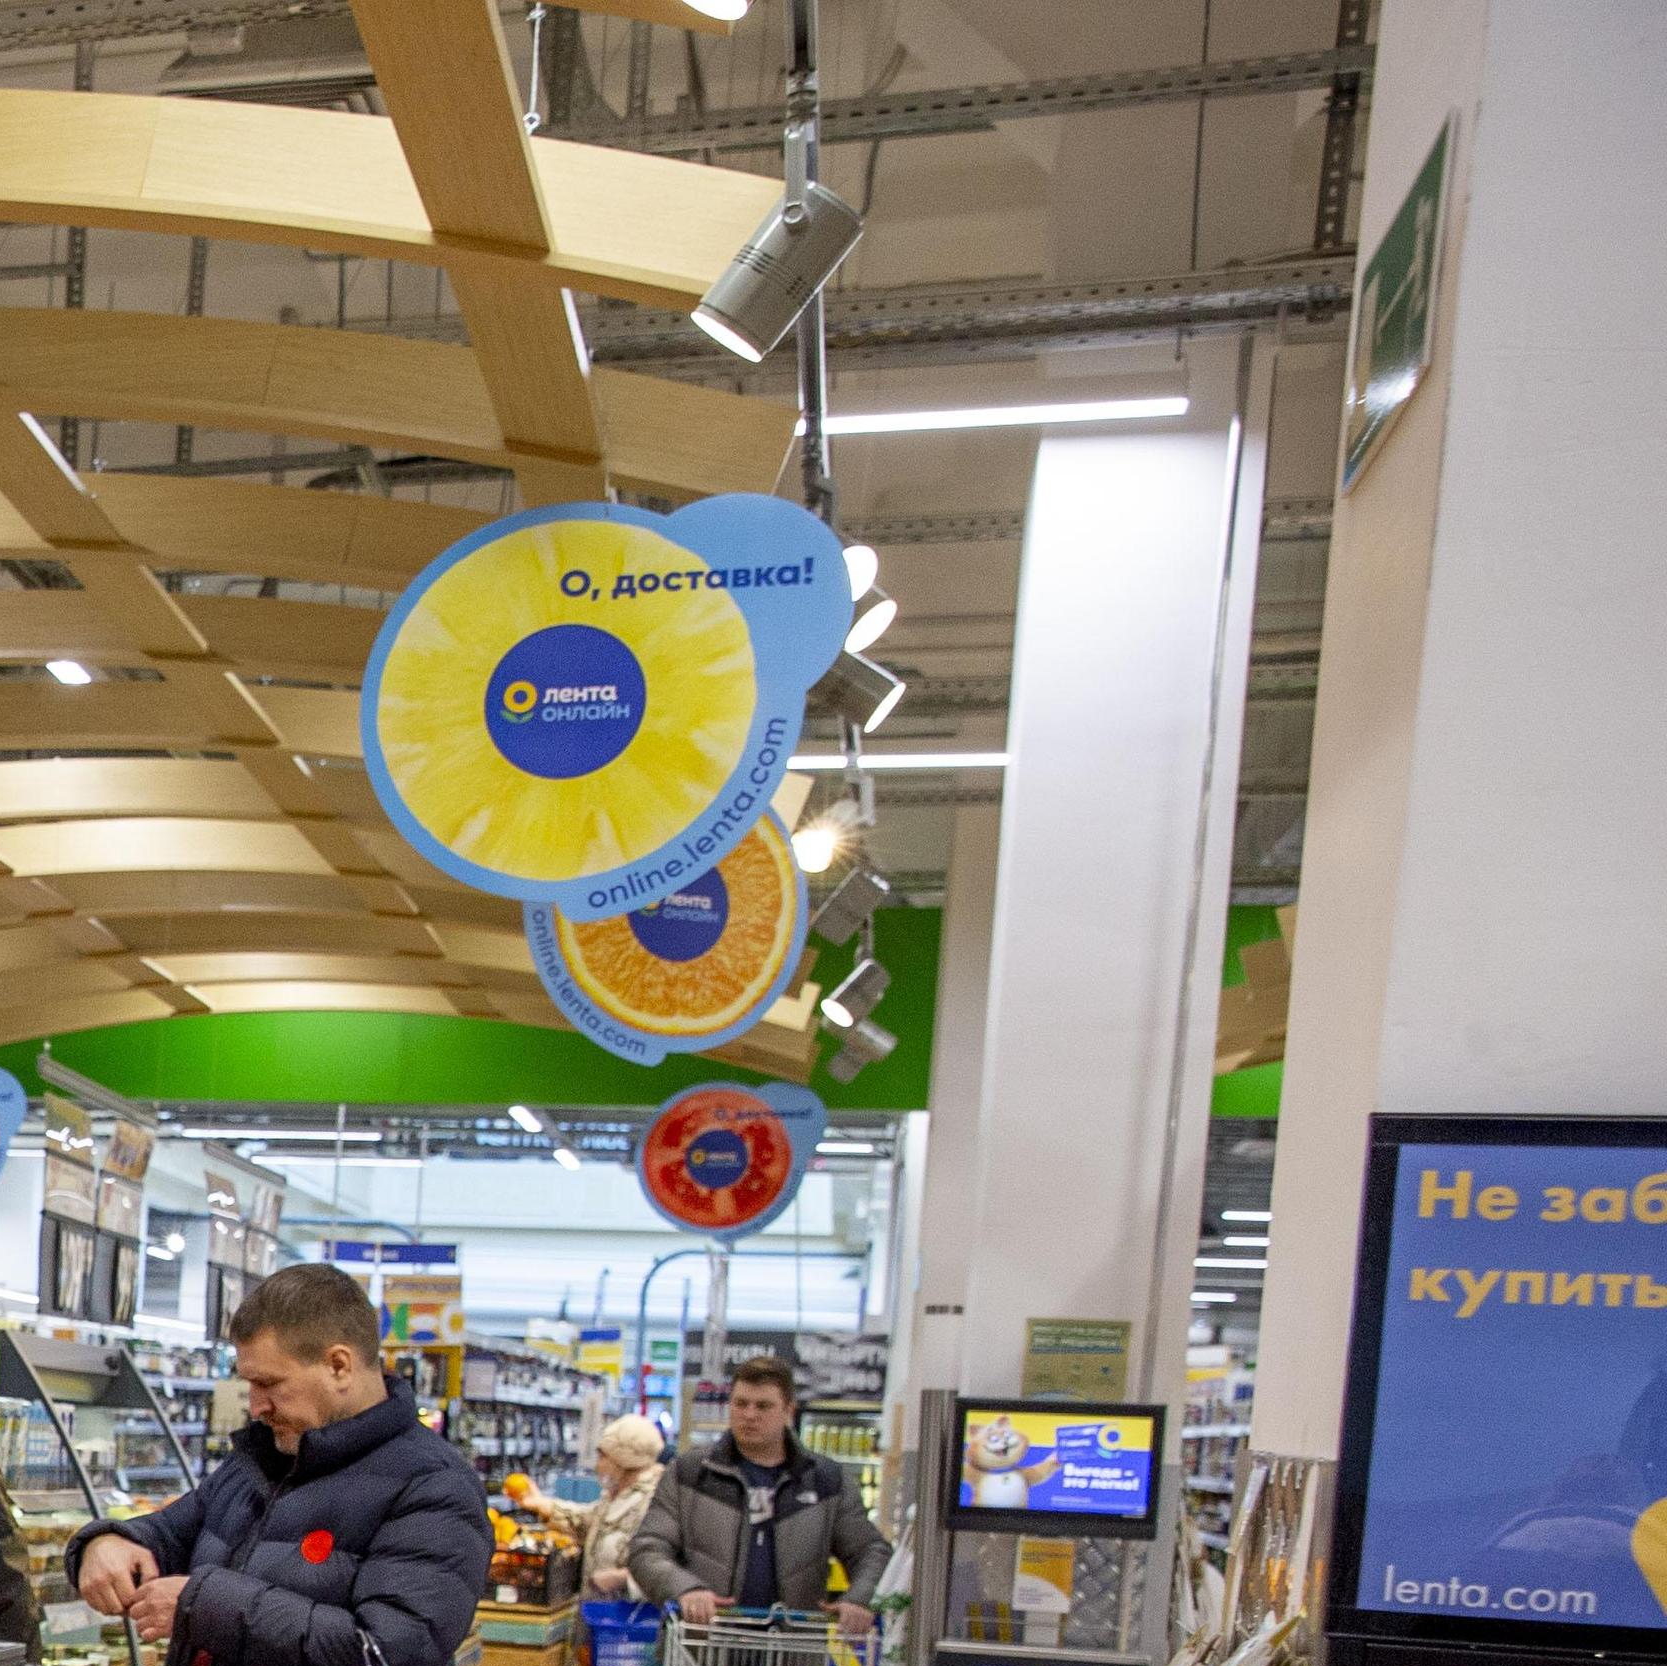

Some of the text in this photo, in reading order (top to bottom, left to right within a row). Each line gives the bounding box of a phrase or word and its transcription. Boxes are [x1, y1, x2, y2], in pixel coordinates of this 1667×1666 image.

[561, 557, 815, 601] О, доставка!
[541, 702, 630, 722] онлайн
[542, 685, 619, 704] лента
[587, 715, 787, 911] online.lenta.com
[532, 910, 647, 1056] online.lenta.com
[1417, 1169, 1520, 1221] Не
[1409, 1266, 1667, 1319] купить
[1382, 1563, 1599, 1617] lenta.com
